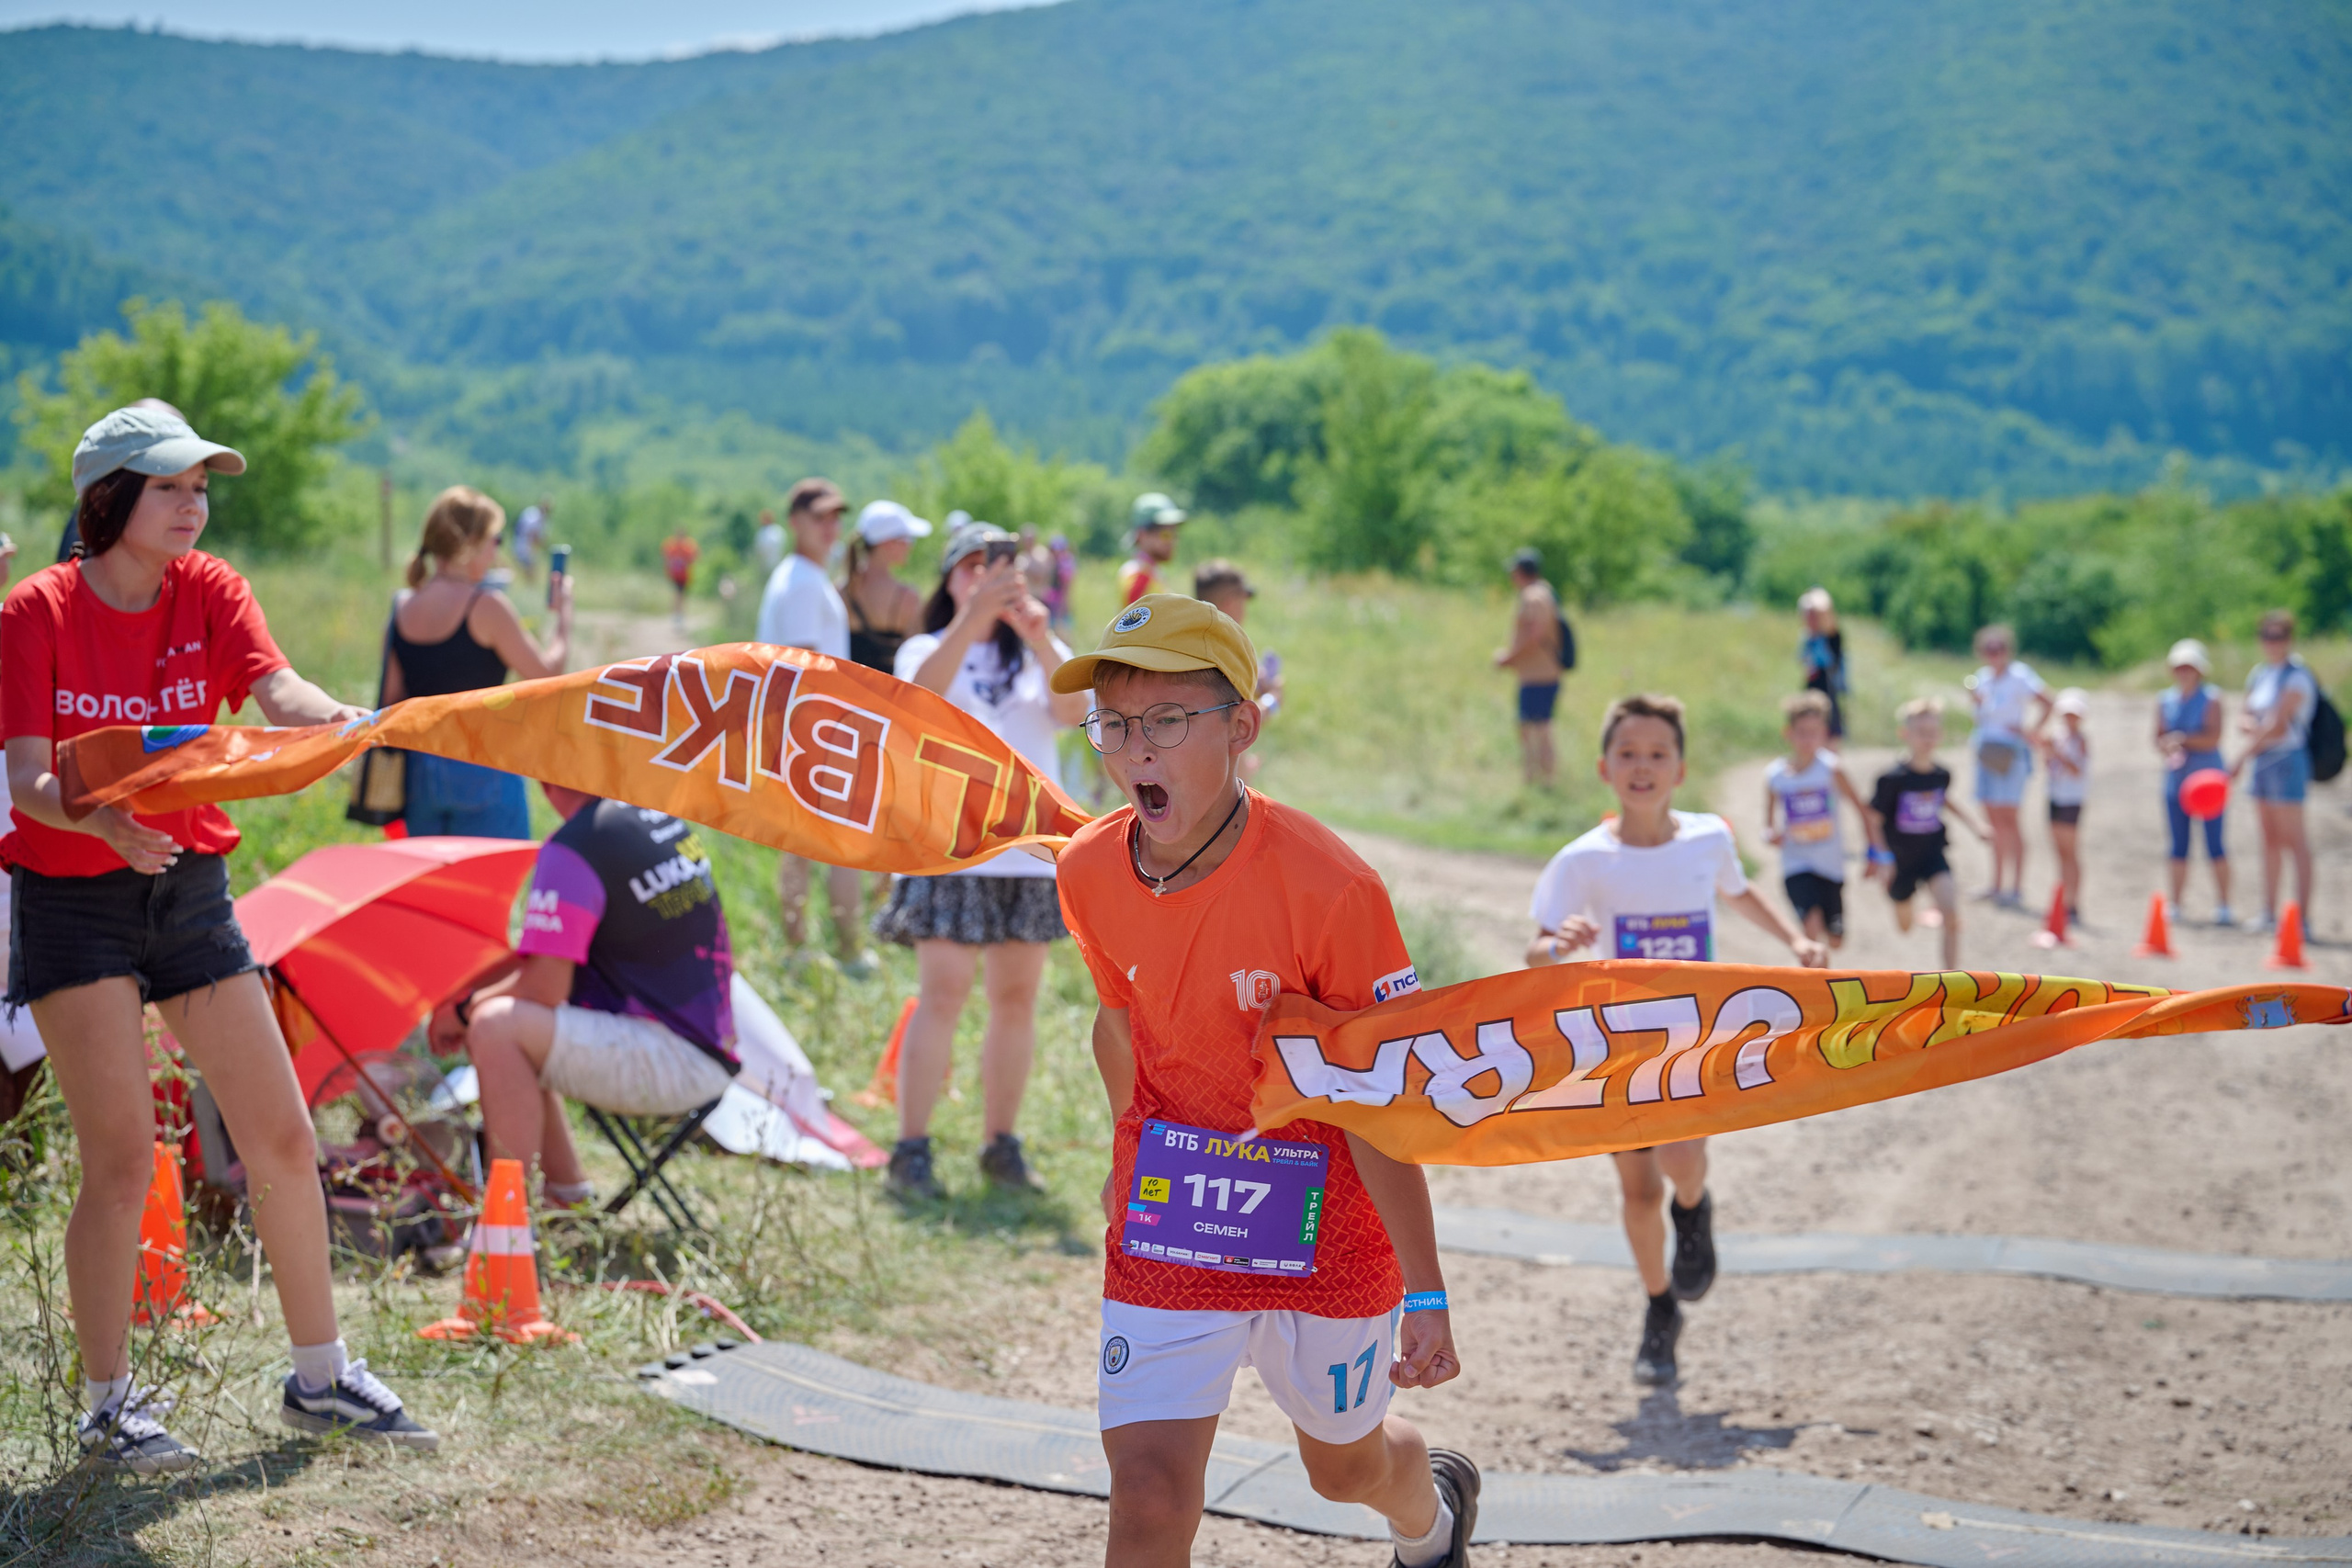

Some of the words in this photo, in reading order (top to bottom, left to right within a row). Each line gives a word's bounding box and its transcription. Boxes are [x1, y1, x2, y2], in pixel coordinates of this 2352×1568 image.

[583, 649, 891, 834] BIKE
[1638, 935, 1697, 959] 123
[1229, 969, 1280, 1011] 10
[1272, 986, 1804, 1129] ULTRA
[1165, 1130, 1199, 1151] ВТБ
[1204, 1138, 1271, 1163] ЛУКА
[1273, 1147, 1319, 1159] УЛЬТРА
[1148, 1179, 1159, 1187] 10
[1183, 1173, 1272, 1214] 117
[1193, 1222, 1249, 1238] СЕМЕН
[1303, 1191, 1319, 1241] ТРЕЙЛ
[1327, 1339, 1378, 1414] 17
